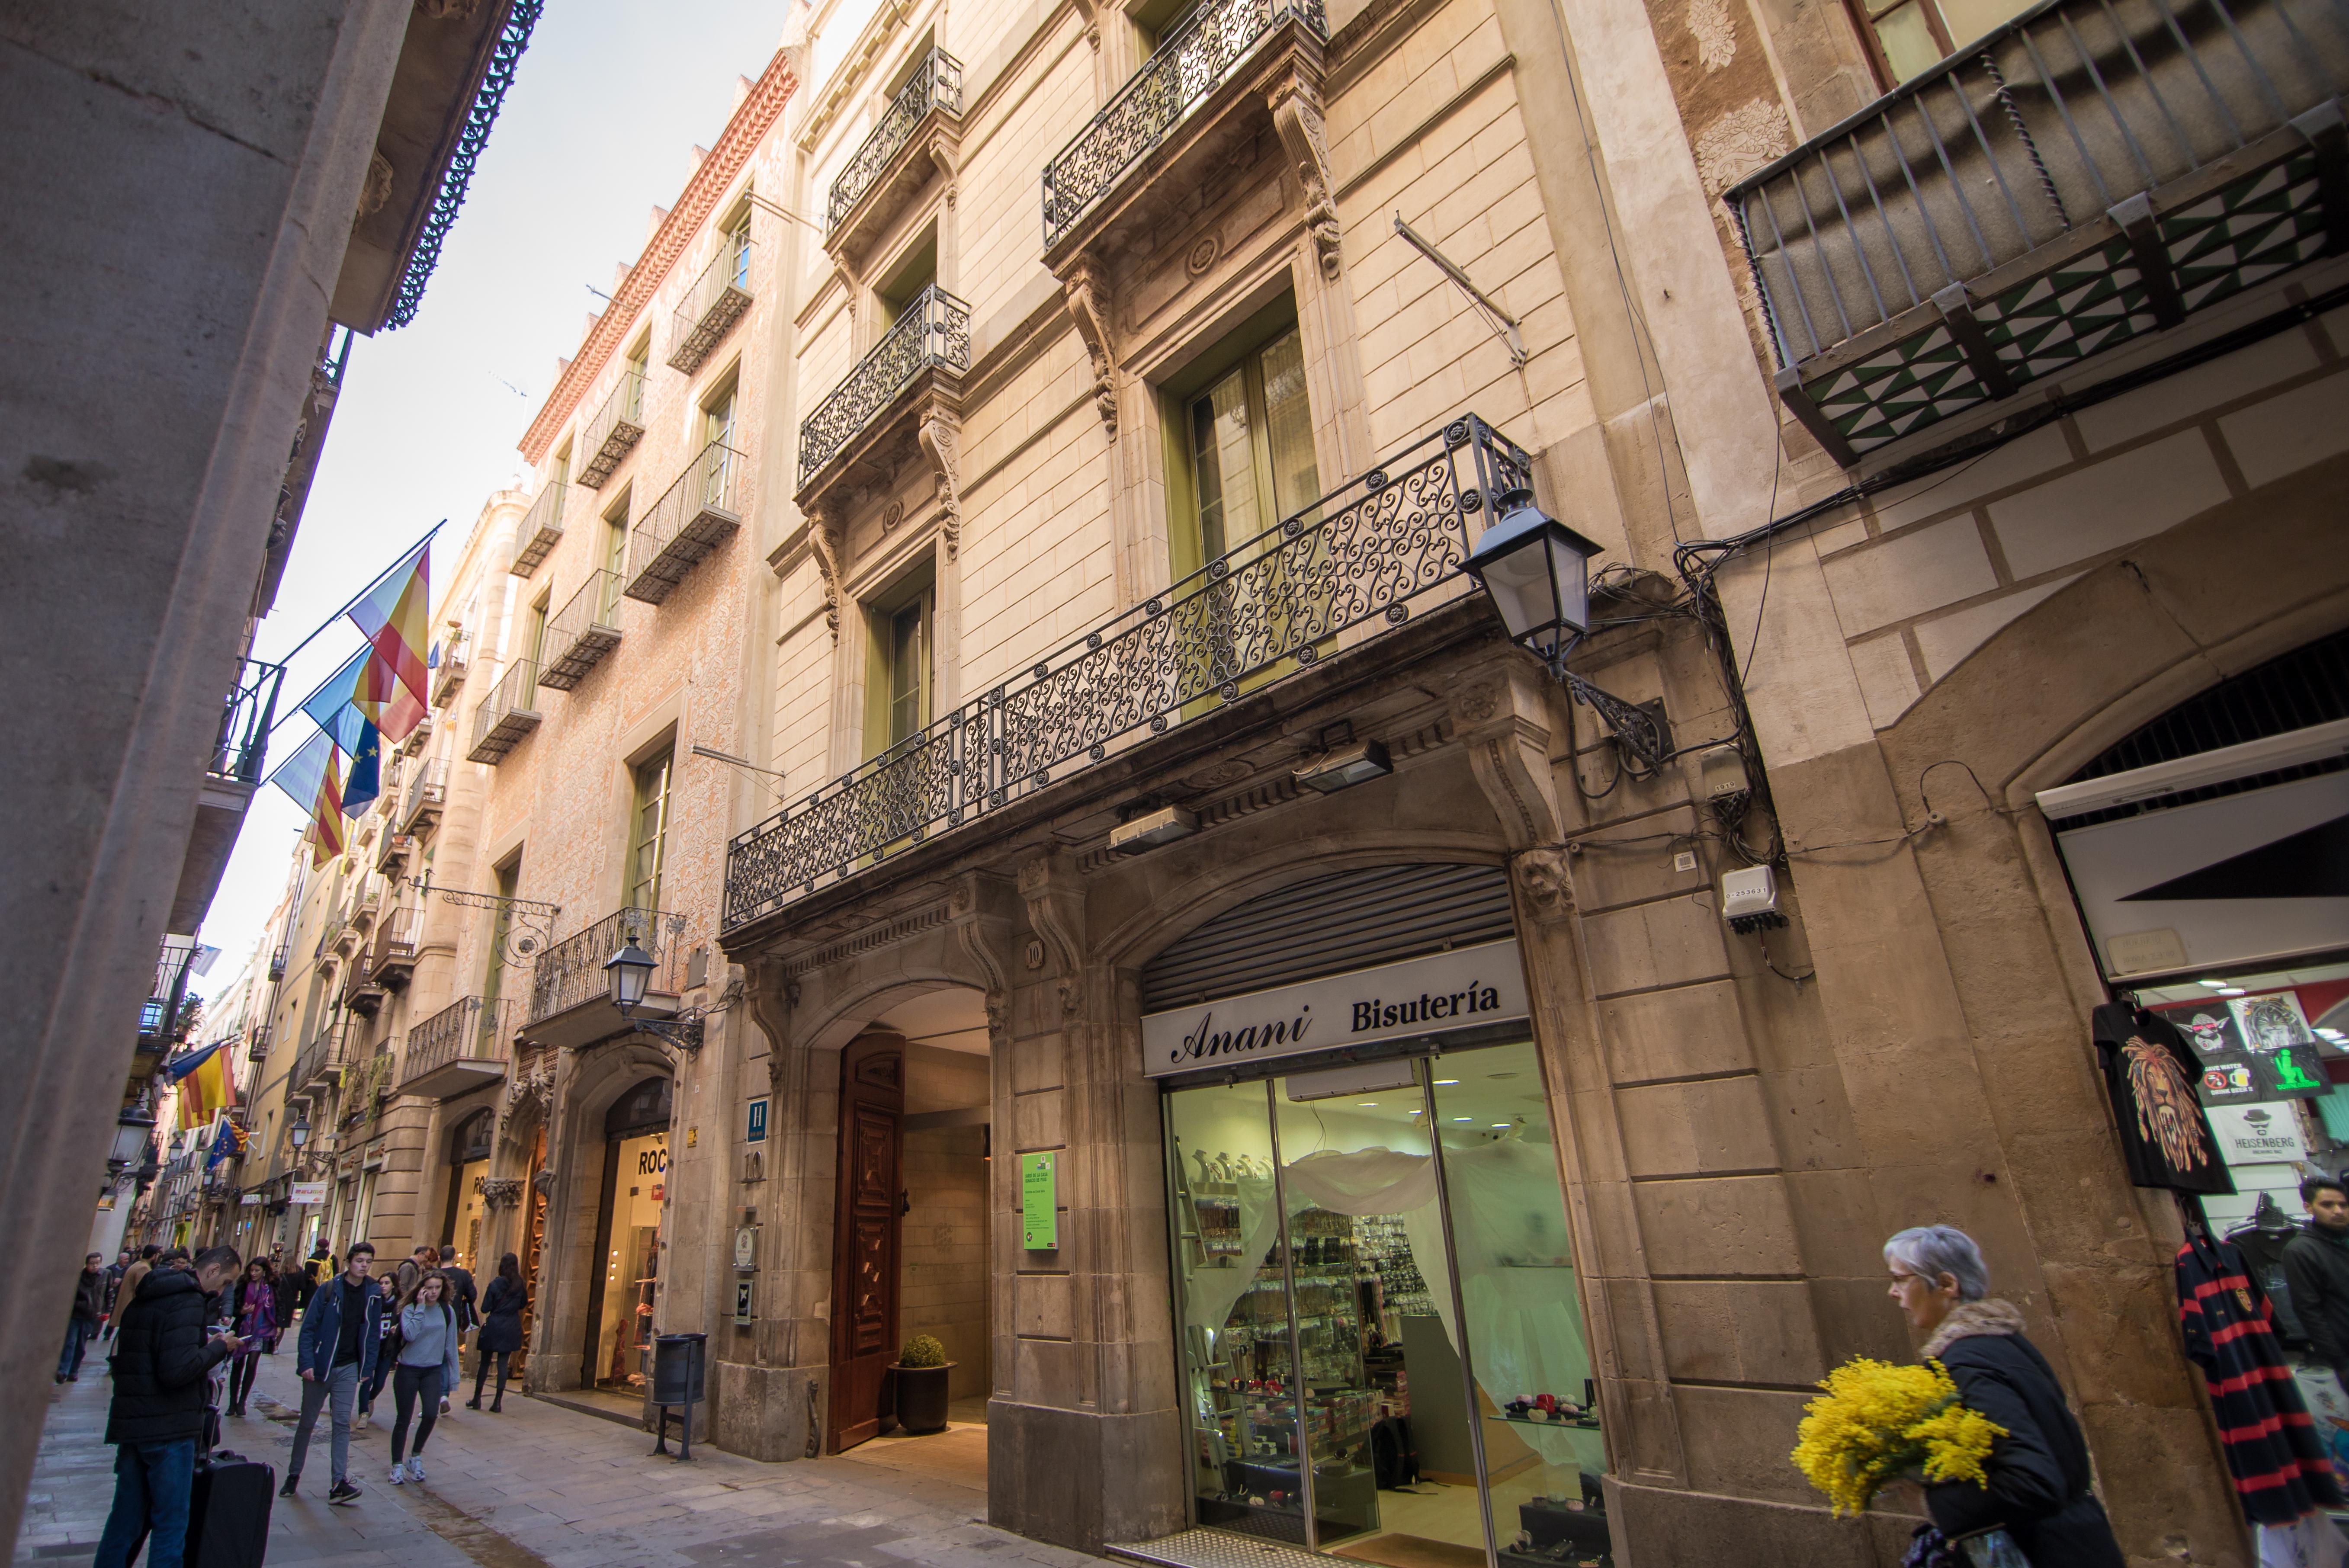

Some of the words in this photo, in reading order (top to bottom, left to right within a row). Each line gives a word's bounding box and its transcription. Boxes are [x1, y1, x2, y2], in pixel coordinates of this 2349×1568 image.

[1716, 782, 1734, 791] 1919
[1726, 888, 1766, 899] 0-253631
[1170, 1004, 1313, 1064] Anani
[1351, 980, 1500, 1033] Bisutería
[2276, 1080, 2321, 1090] DOWNLOADING
[752, 1105, 763, 1127] H
[2234, 1137, 2295, 1149] HEISENBERG
[744, 1151, 765, 1180] 10
